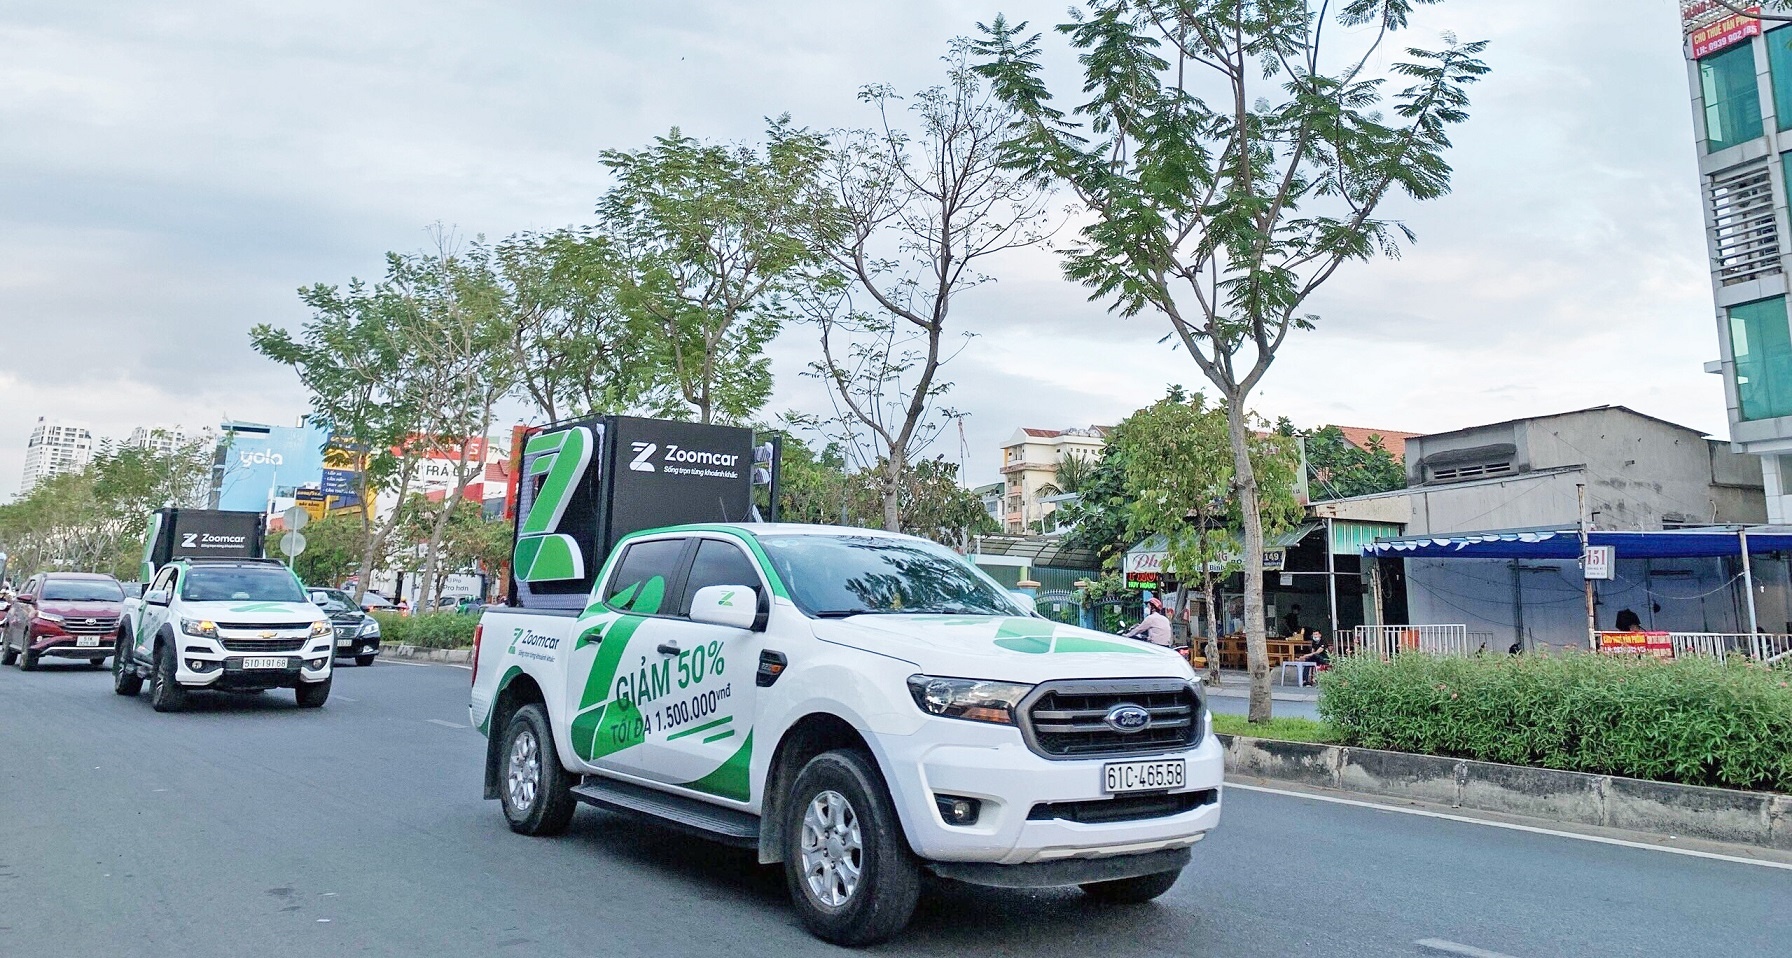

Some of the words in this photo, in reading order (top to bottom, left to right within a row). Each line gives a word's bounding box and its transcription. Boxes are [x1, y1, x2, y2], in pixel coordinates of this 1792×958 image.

[1694, 30, 1706, 44] CHO
[1708, 38, 1726, 50] 0939
[1728, 31, 1742, 43] 902
[240, 448, 283, 468] yola
[664, 444, 738, 466] Zoomcar
[664, 466, 678, 474] Sống
[202, 534, 246, 543] Zoomcar
[1264, 552, 1279, 560] 149
[1587, 550, 1605, 565] 151
[522, 630, 560, 650] Zoomcar
[616, 656, 670, 711] GIẢM
[678, 640, 724, 689] 50%
[1121, 711, 1144, 725] Ford
[610, 714, 630, 744] TỐI
[633, 714, 652, 738] ĐA
